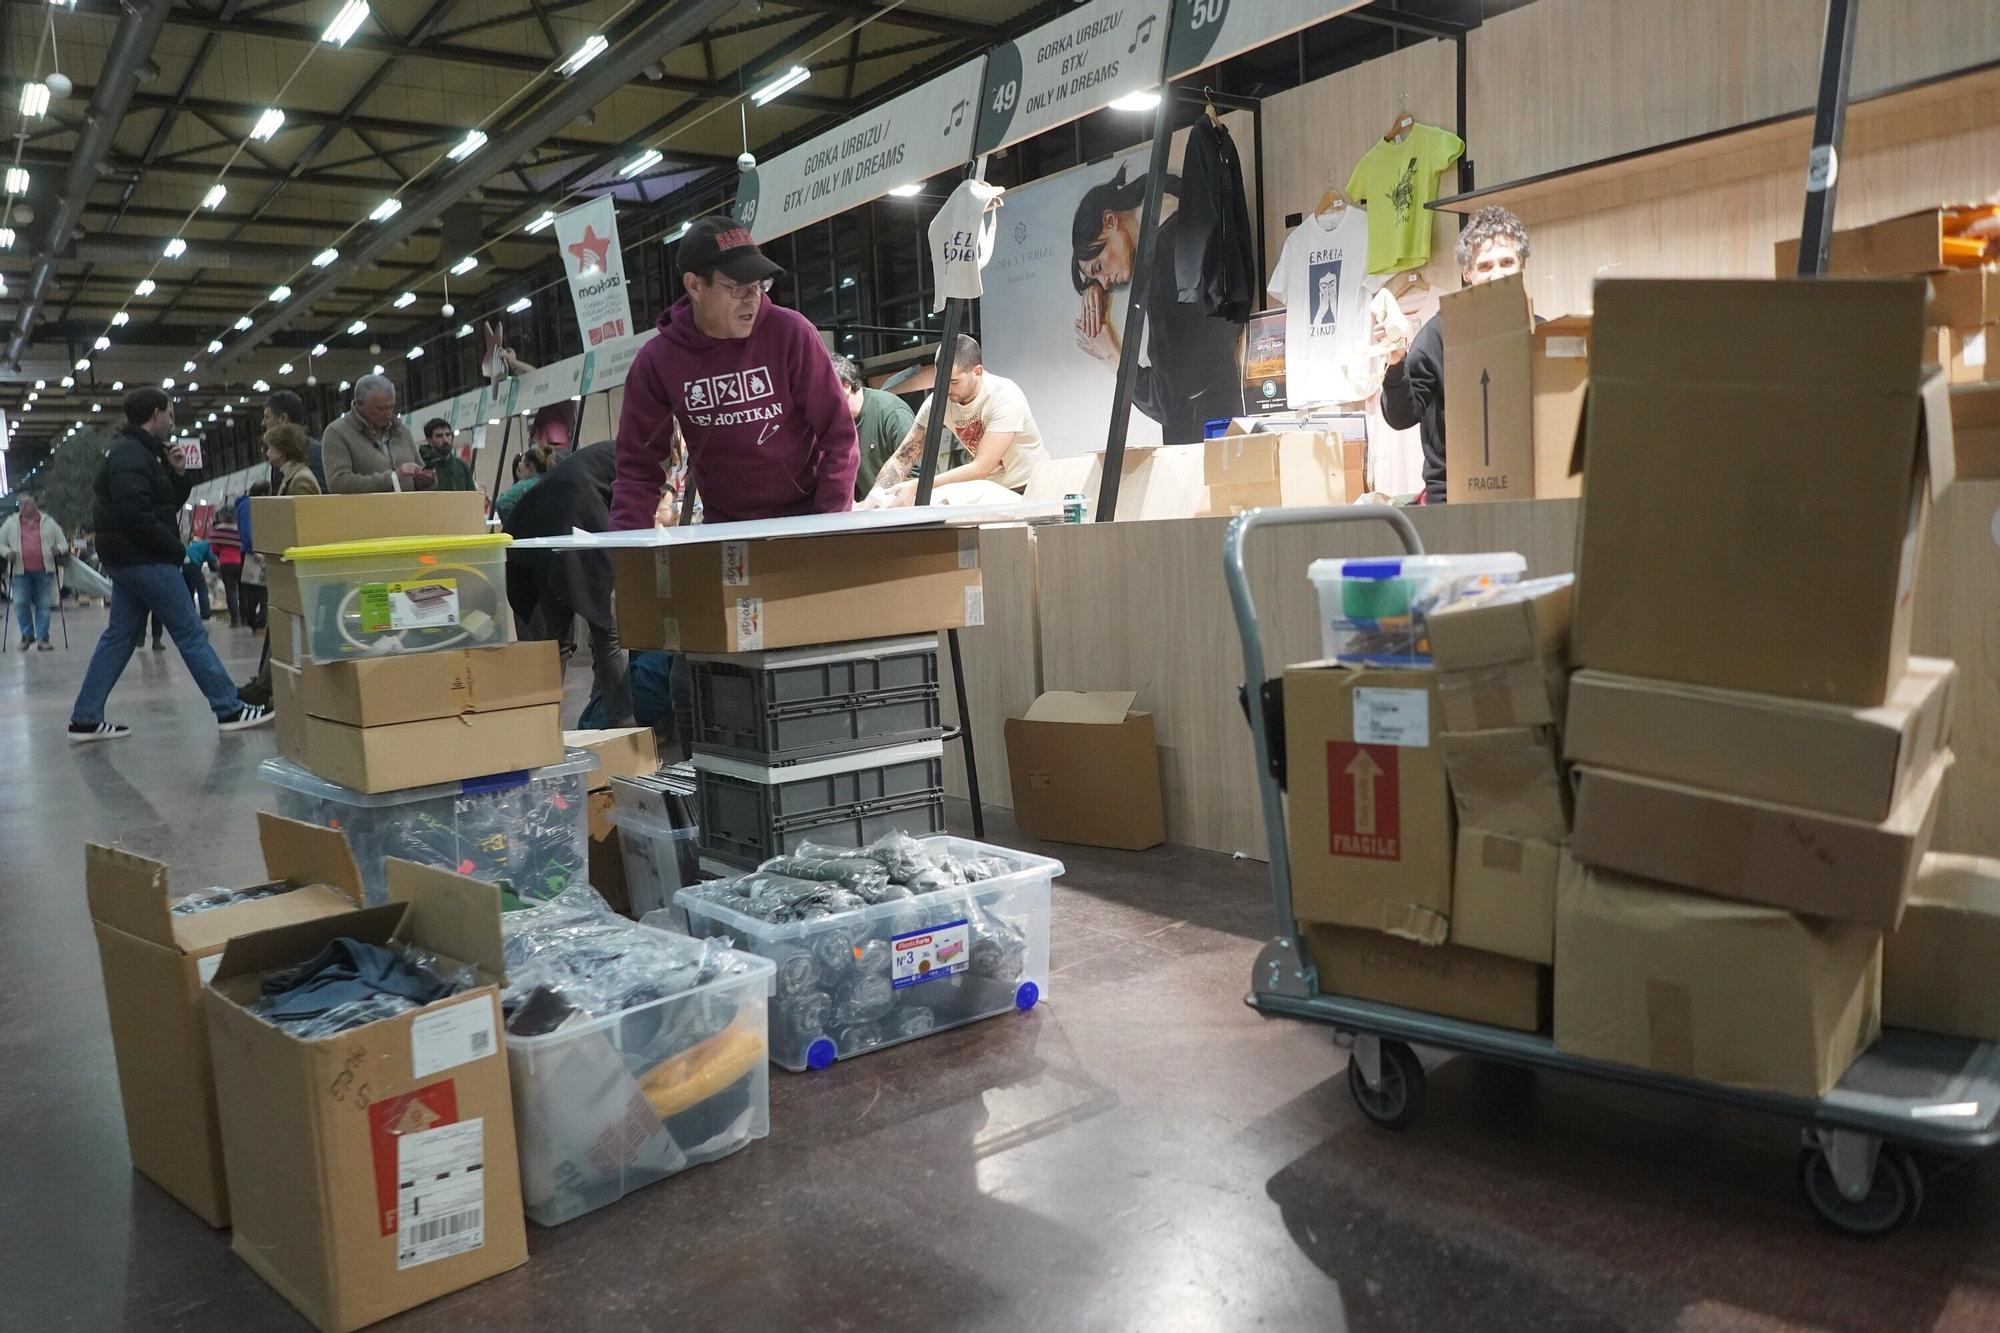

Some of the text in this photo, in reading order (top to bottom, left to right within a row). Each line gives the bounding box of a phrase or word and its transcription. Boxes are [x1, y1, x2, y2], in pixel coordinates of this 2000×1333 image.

[1190, 0, 1222, 30] 50
[1036, 8, 1124, 64] GORKA URBIZU/
[1060, 49, 1089, 76] BTX/
[992, 79, 1017, 114] 49
[1025, 60, 1120, 115] ONLY IN DREAMS
[803, 118, 891, 177] GORKA URBIZU /
[782, 189, 804, 213] BTX
[811, 175, 839, 201] ONLY
[841, 168, 854, 188] IN
[855, 143, 906, 181] DREAMS
[741, 199, 755, 225] 48
[1468, 475, 1508, 492] FRAGILE
[1332, 832, 1397, 857] FRAGILE
